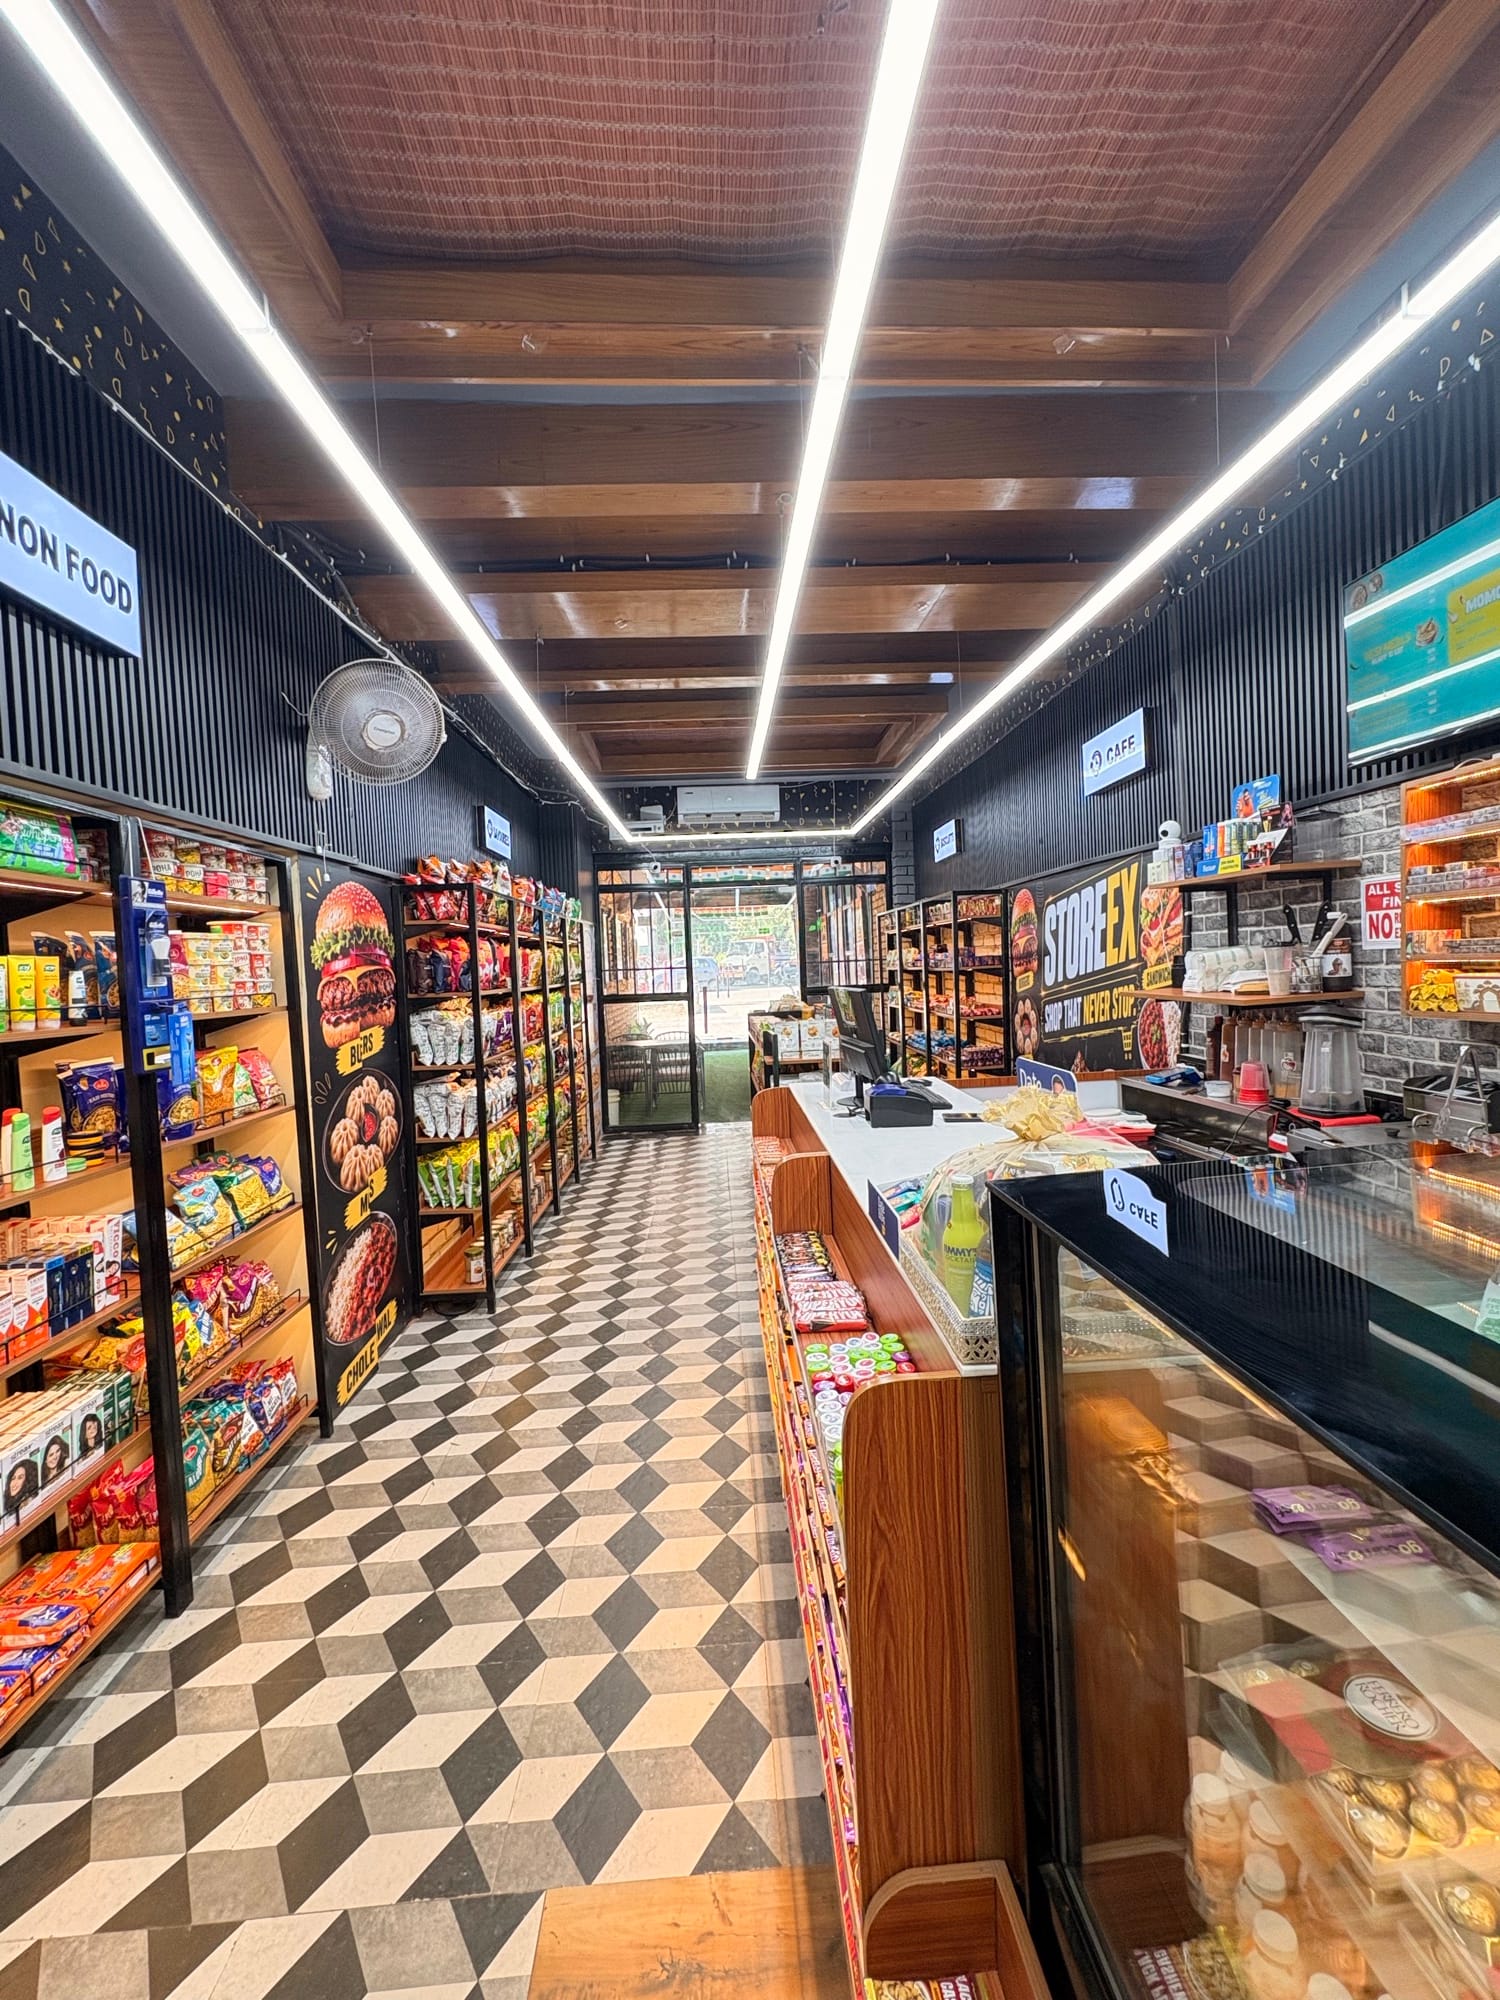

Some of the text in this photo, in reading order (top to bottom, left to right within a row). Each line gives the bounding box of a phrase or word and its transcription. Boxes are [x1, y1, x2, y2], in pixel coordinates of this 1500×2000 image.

[0, 499, 132, 614] NON FOOD
[1106, 734, 1135, 765] CAFE
[1367, 883, 1391, 896] ALL
[1368, 912, 1393, 939] NO
[1044, 1001, 1063, 1034] SHOP
[1063, 996, 1083, 1030] THAT
[1083, 989, 1111, 1025] NEVER
[112, 1219, 121, 1259] VICCO
[346, 1342, 376, 1394] CHOLE
[1354, 1682, 1401, 1732] ROCHER
[1366, 1680, 1420, 1729] FERRERO
